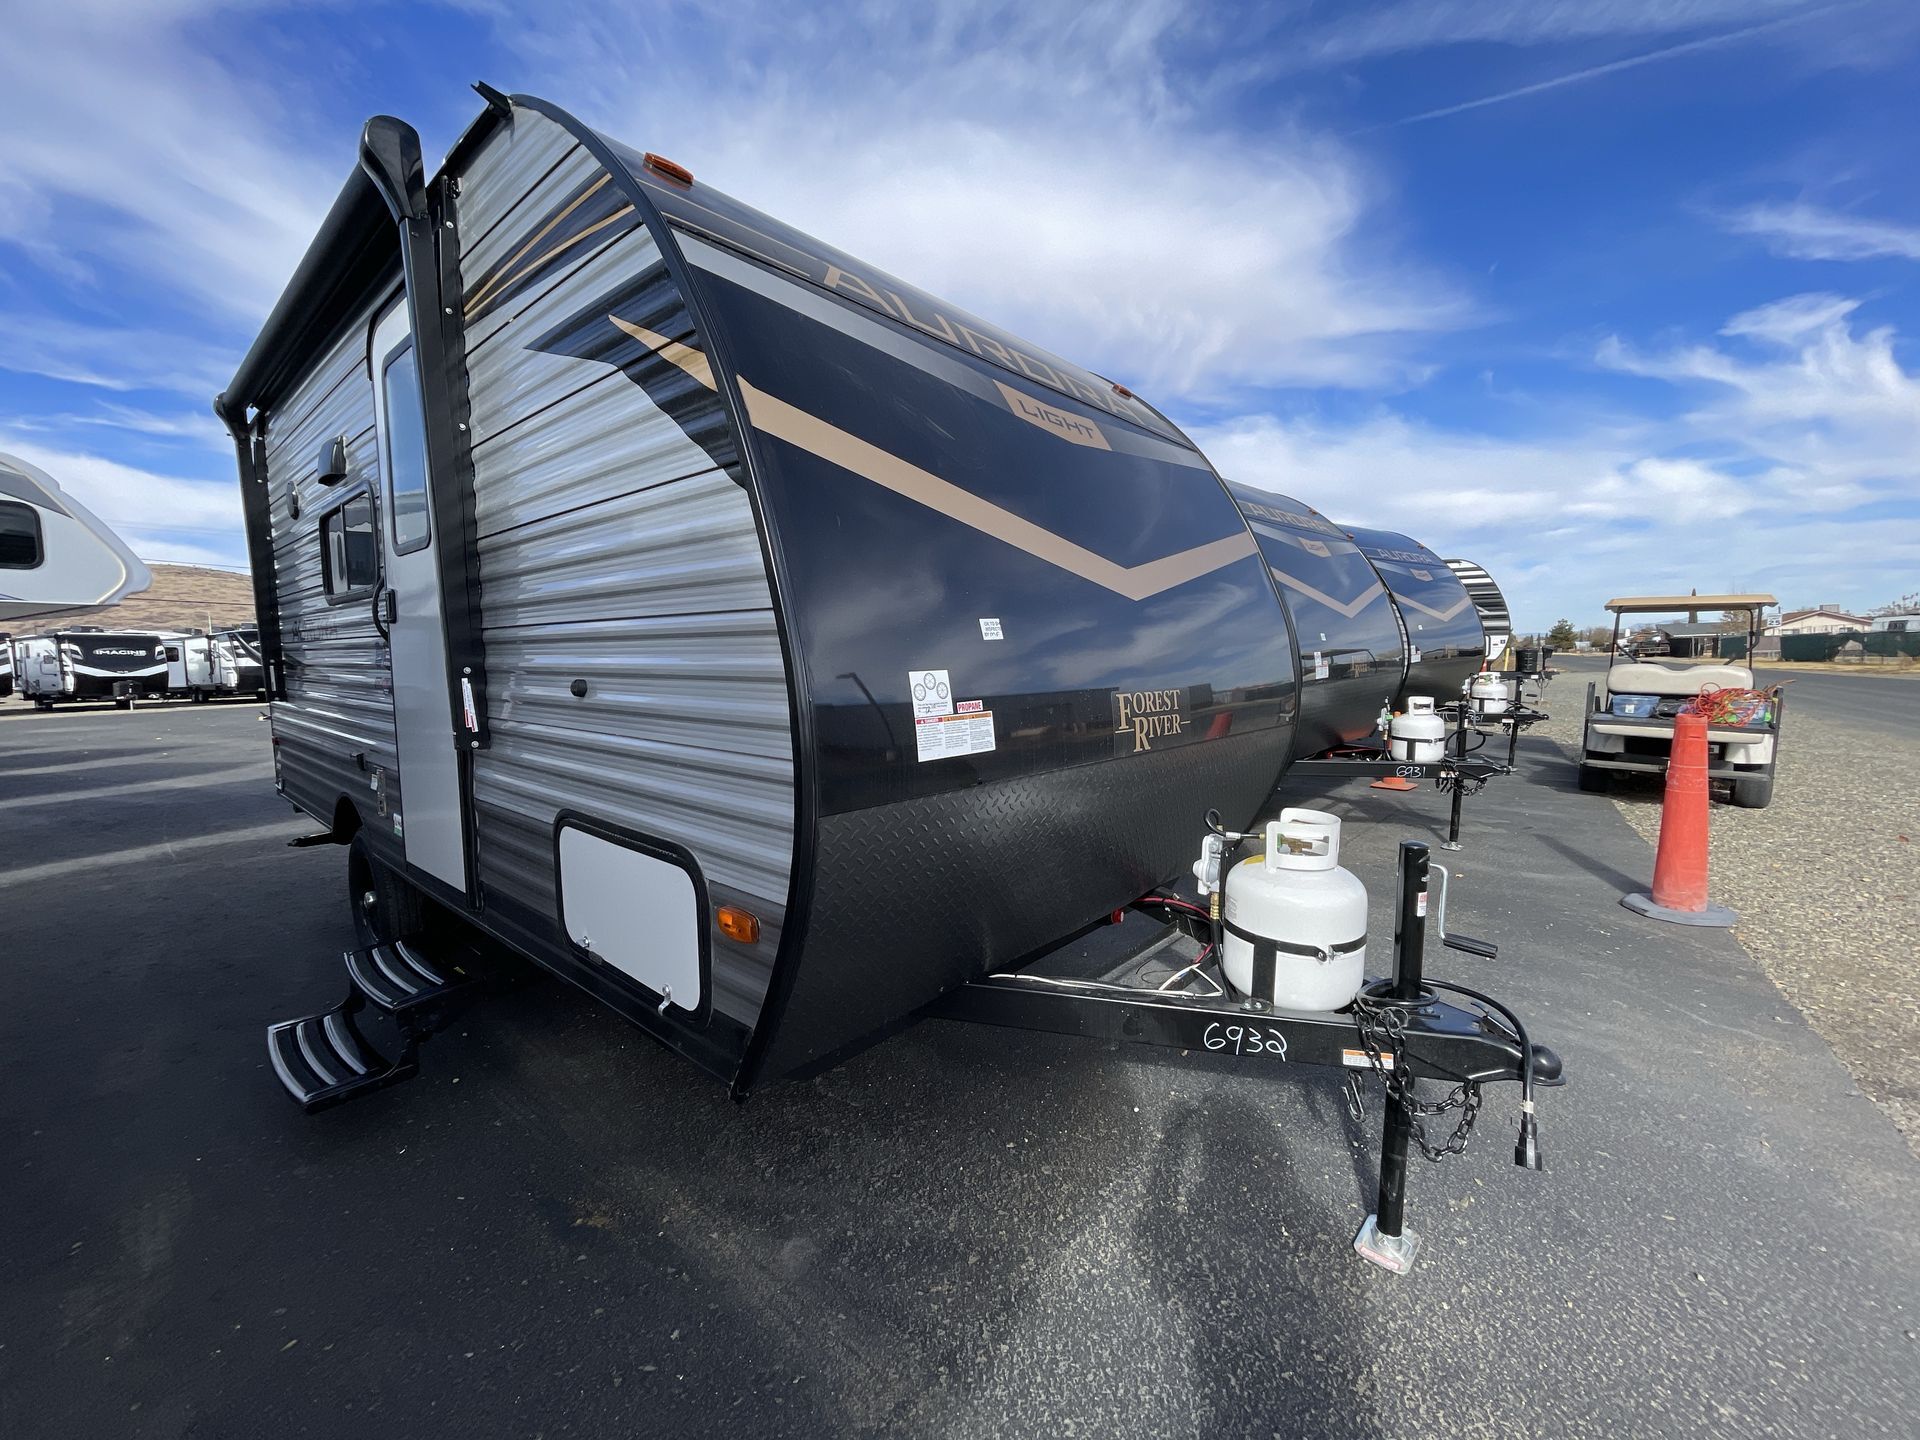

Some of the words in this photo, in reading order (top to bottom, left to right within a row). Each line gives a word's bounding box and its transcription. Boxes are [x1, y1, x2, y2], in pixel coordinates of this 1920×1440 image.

[823, 264, 1145, 425] AURORA
[1016, 398, 1093, 440] LIGHT
[94, 648, 147, 656] IMAGINE
[957, 701, 982, 712] PROPANE
[1116, 689, 1180, 730] FOREST
[1133, 713, 1182, 753] RIVER
[1396, 765, 1426, 778] 6931
[1203, 1022, 1288, 1062] 6932
